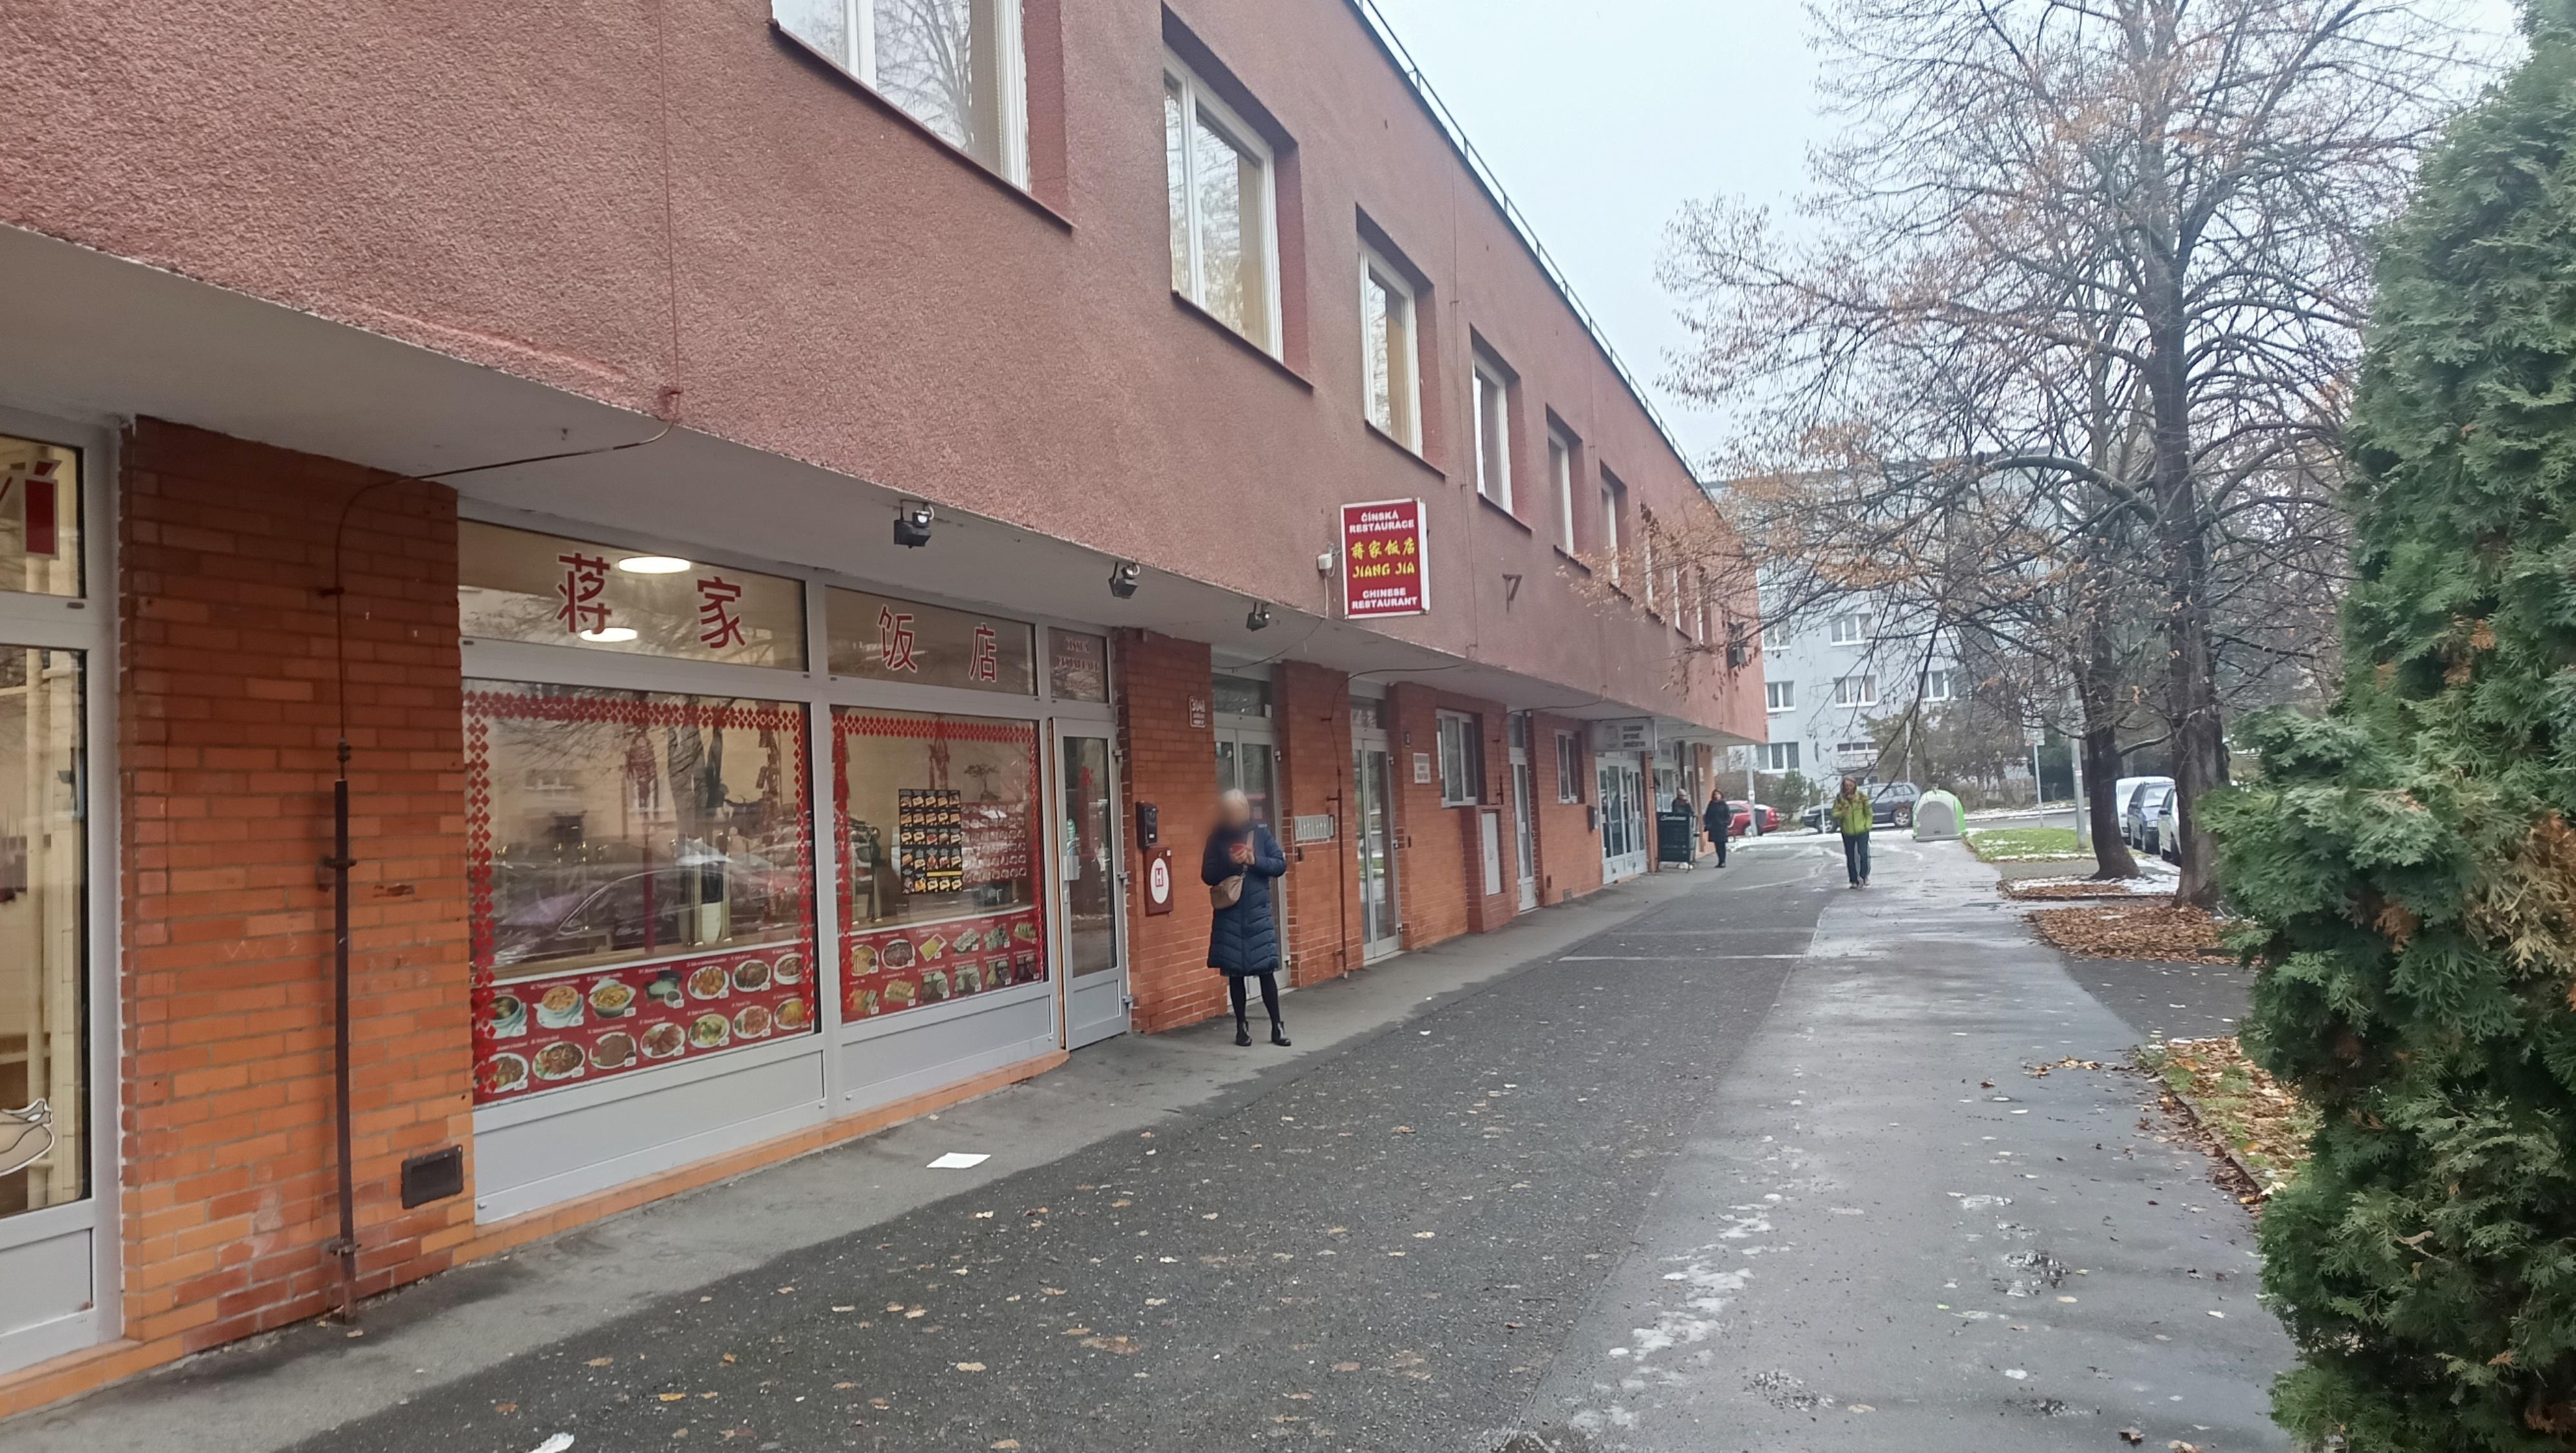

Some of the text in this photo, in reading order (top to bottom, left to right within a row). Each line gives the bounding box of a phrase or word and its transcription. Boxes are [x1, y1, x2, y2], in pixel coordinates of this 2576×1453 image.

[1349, 520, 1414, 533] RESTAURACE
[1352, 562, 1415, 578] JIANG JIA
[1363, 587, 1406, 599] CHINESE
[1352, 596, 1417, 609] RESTAURANT
